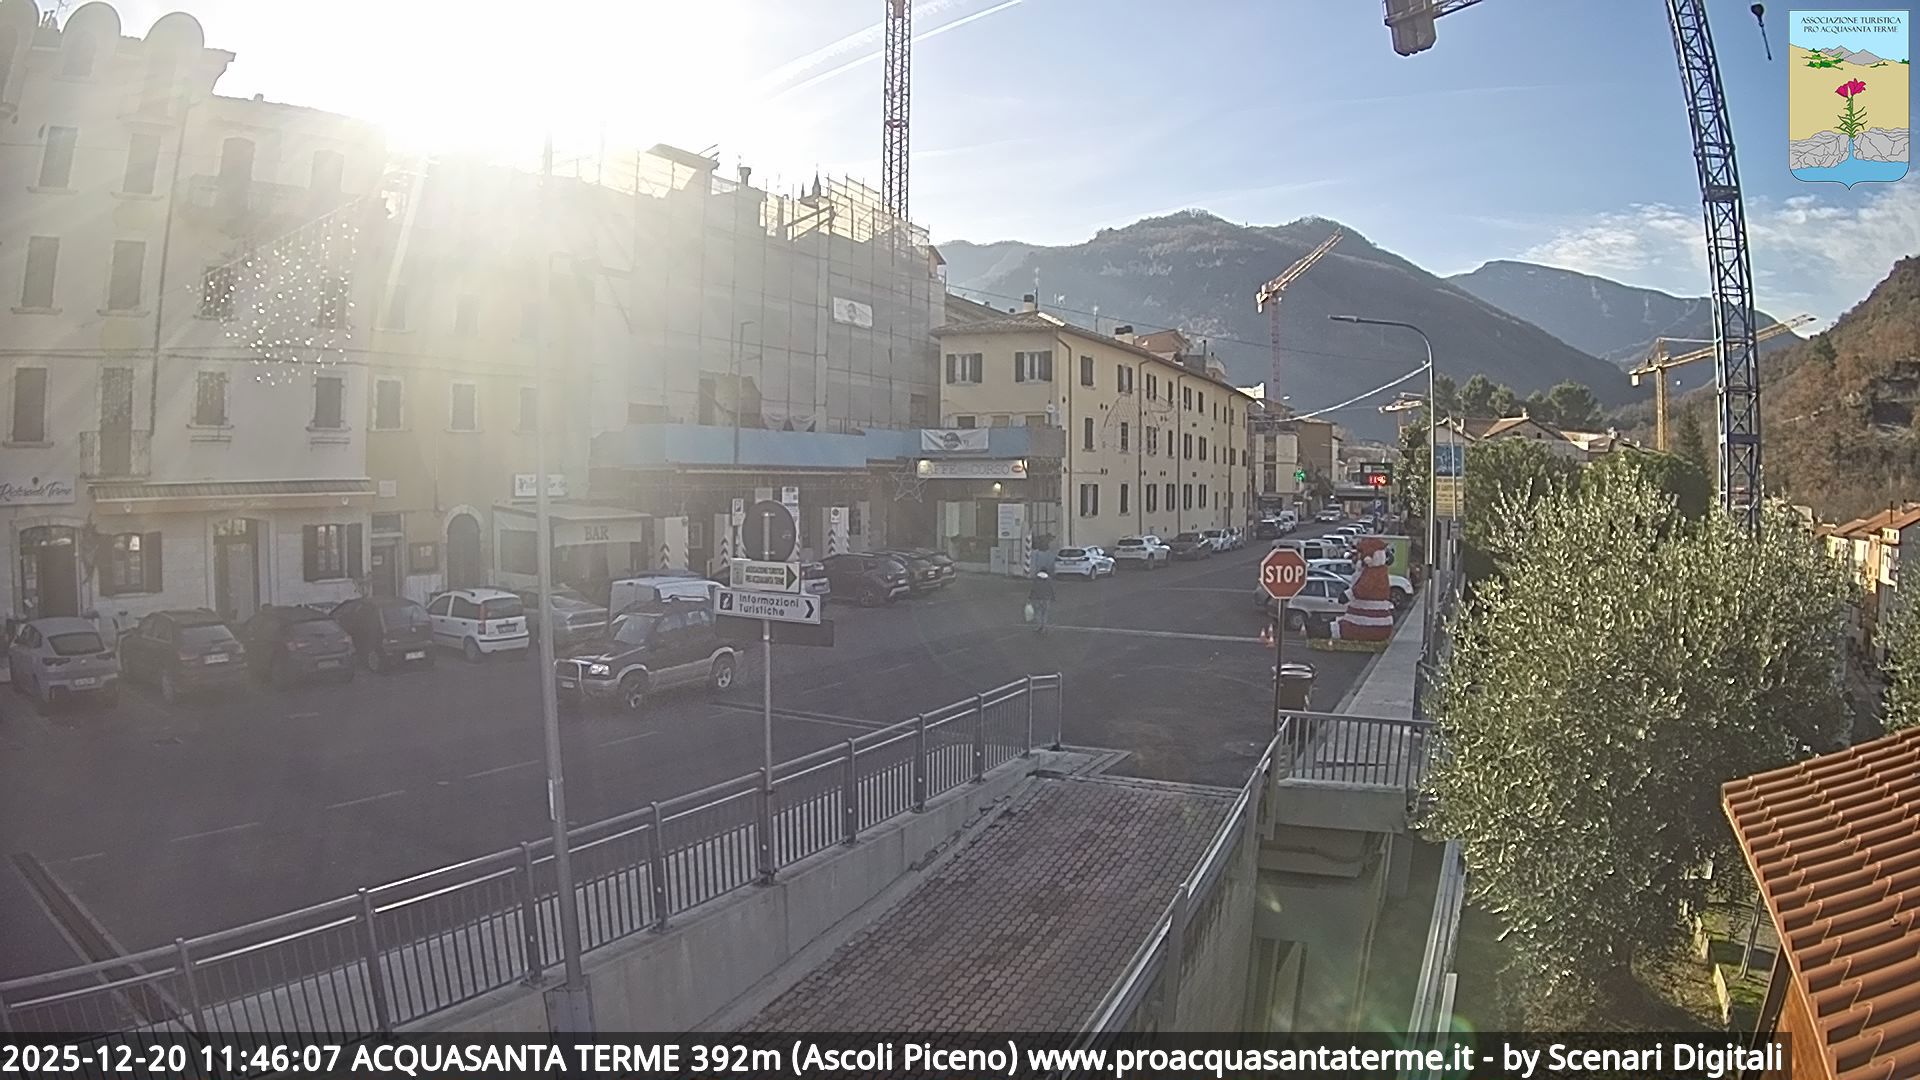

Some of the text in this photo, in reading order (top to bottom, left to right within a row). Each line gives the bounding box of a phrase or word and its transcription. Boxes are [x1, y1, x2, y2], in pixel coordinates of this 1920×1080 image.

[971, 463, 1010, 475] CORSO
[584, 525, 609, 541] BAR
[1265, 565, 1304, 583] STOP
[739, 593, 799, 608] Informazioni
[739, 604, 785, 617] Turistiche
